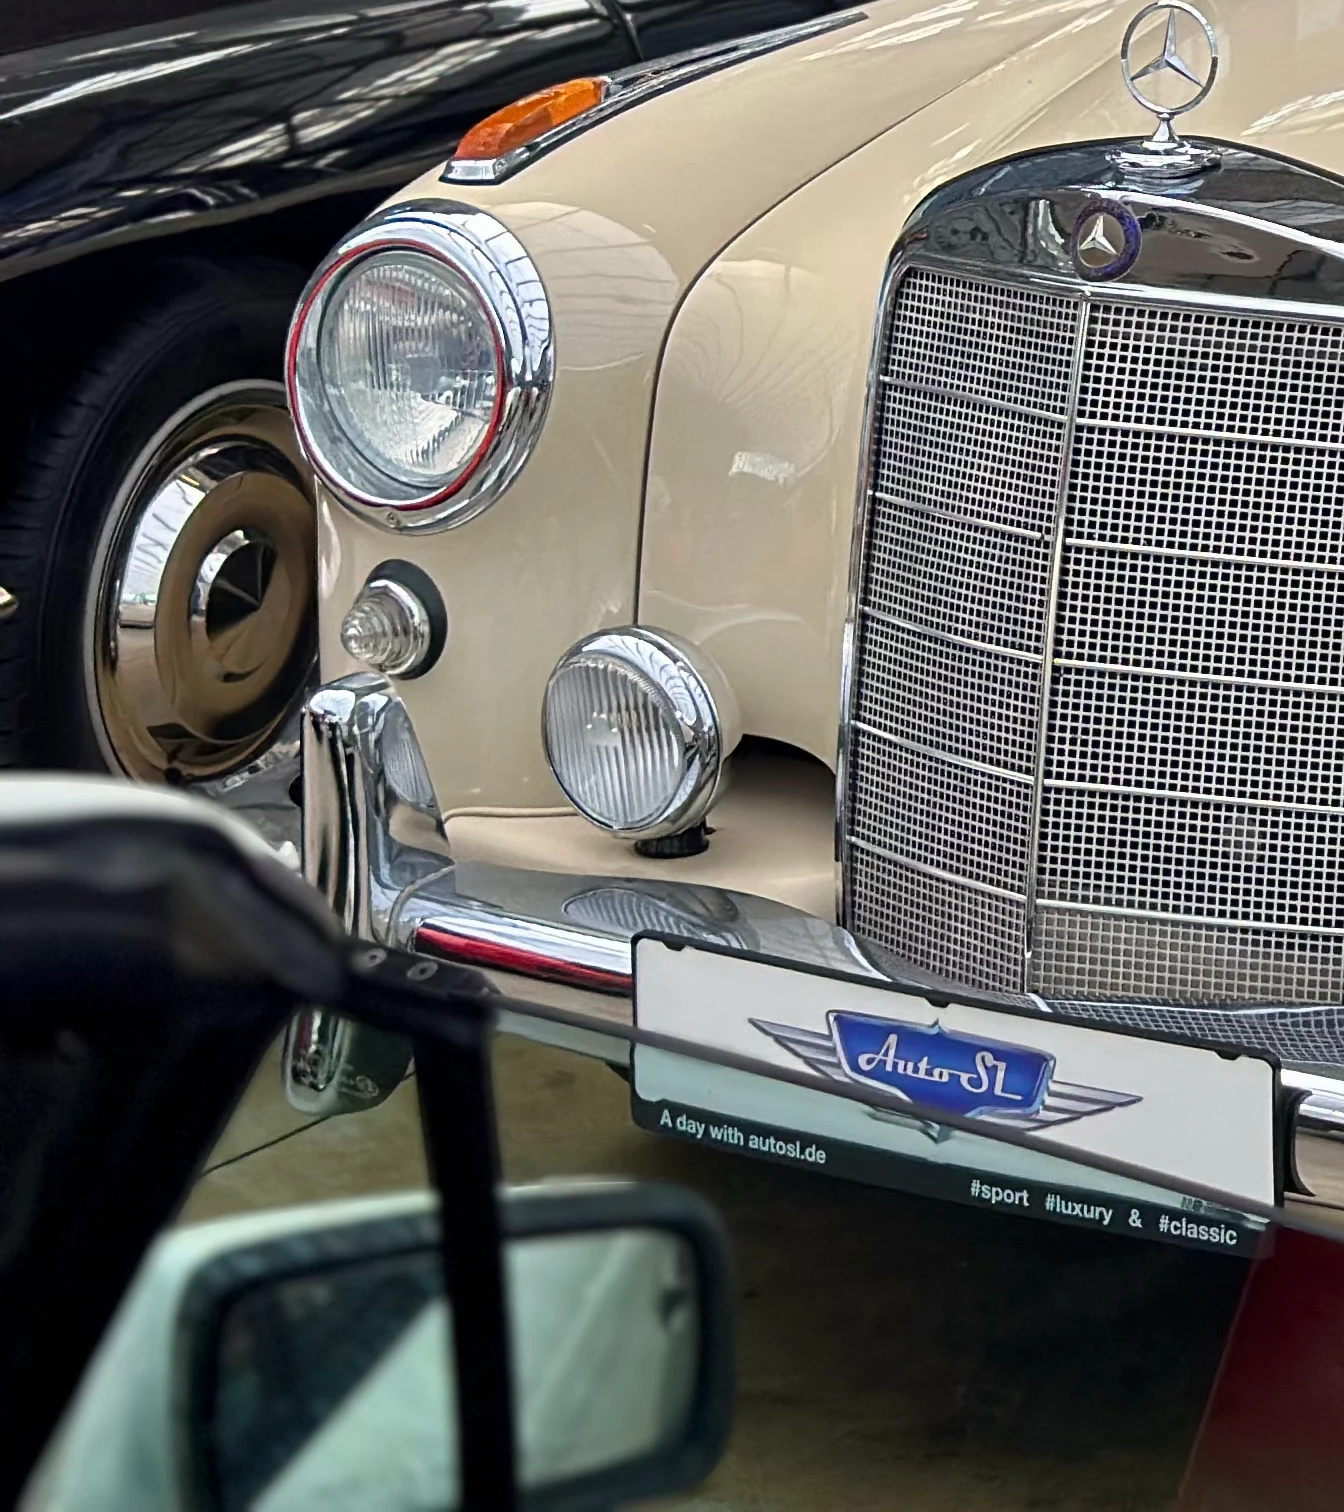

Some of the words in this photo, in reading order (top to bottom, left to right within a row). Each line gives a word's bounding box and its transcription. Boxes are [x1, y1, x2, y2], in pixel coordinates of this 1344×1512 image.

[660, 1108, 673, 1128] A
[676, 1113, 706, 1139] day
[709, 1124, 744, 1147] with
[748, 1134, 827, 1164] autosl.de
[970, 1179, 1030, 1207] #sport
[1045, 1192, 1113, 1226] #luxury
[1128, 1209, 1143, 1228] &
[1159, 1215, 1239, 1246] #classic
